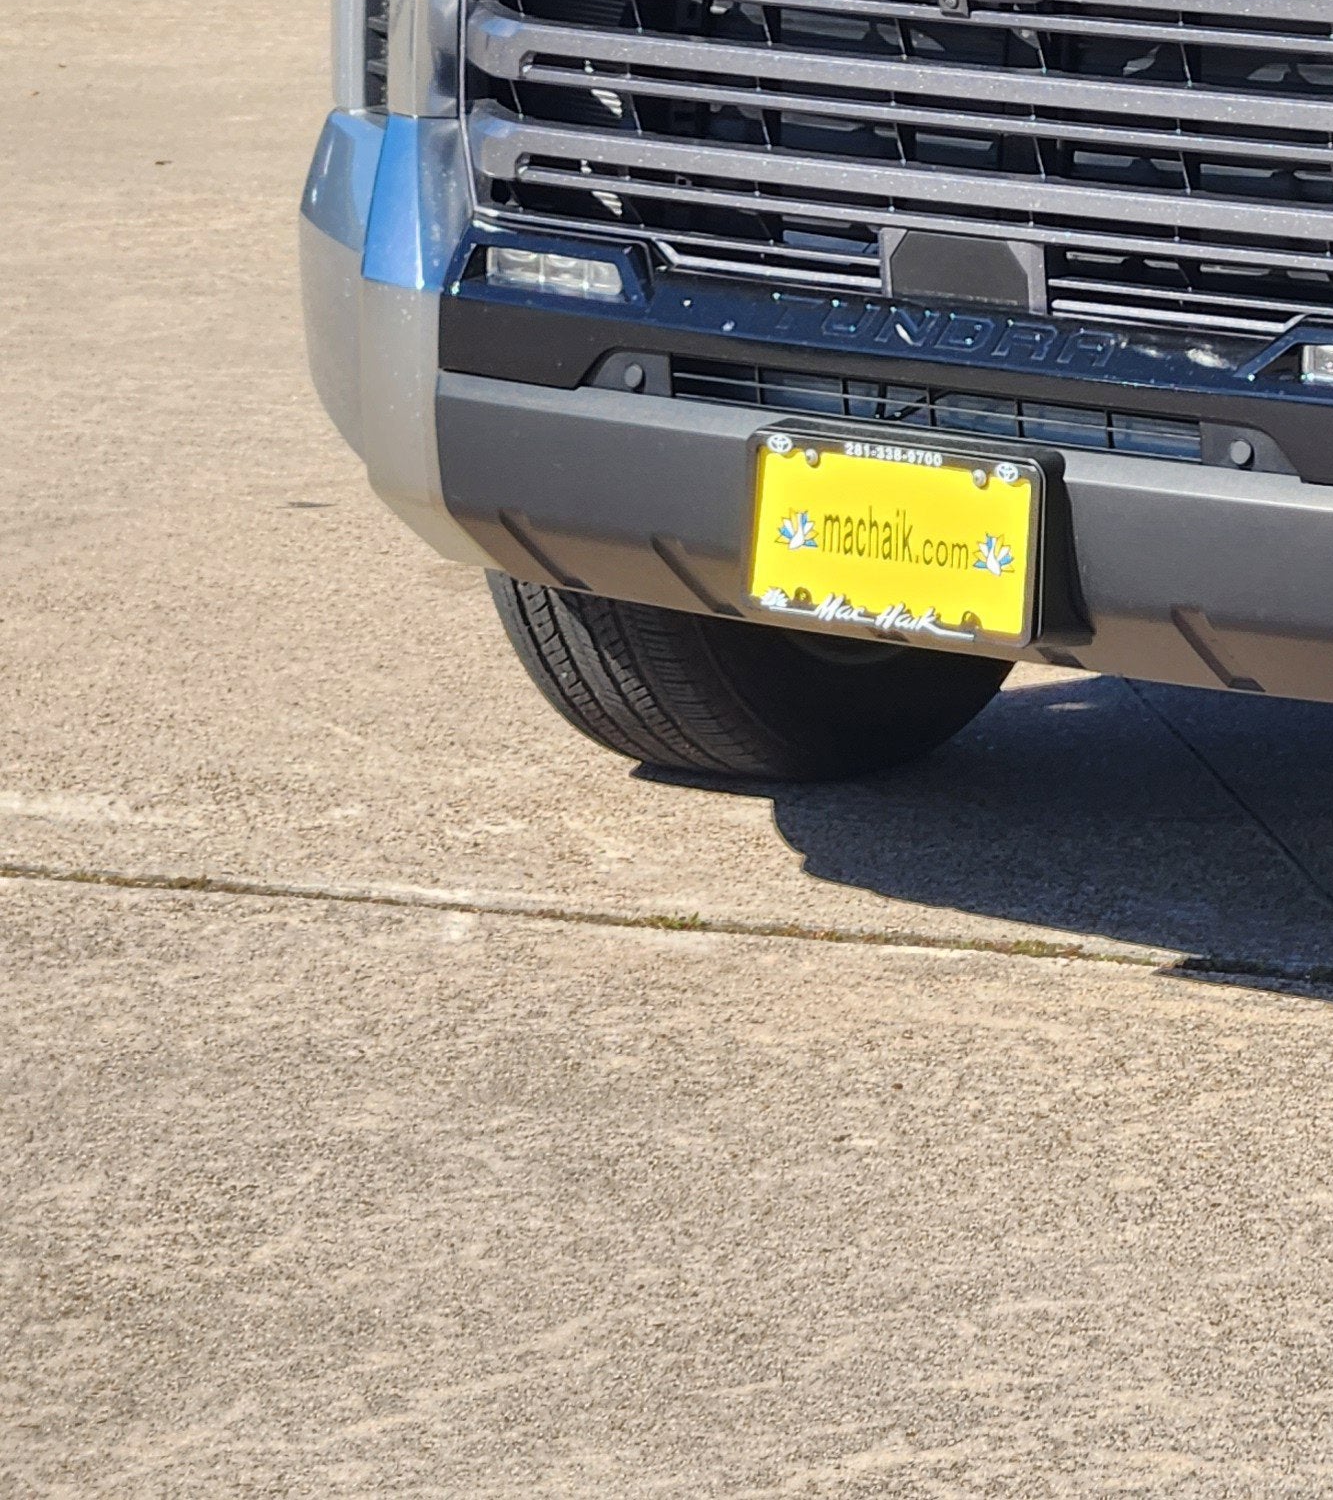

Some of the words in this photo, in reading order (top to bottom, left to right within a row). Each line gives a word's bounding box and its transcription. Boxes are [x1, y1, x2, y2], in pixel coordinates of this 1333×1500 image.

[772, 292, 1121, 367] TUNDRA
[822, 505, 969, 570] machaik.com
[814, 592, 874, 622] Mac
[875, 602, 956, 635] Haik
